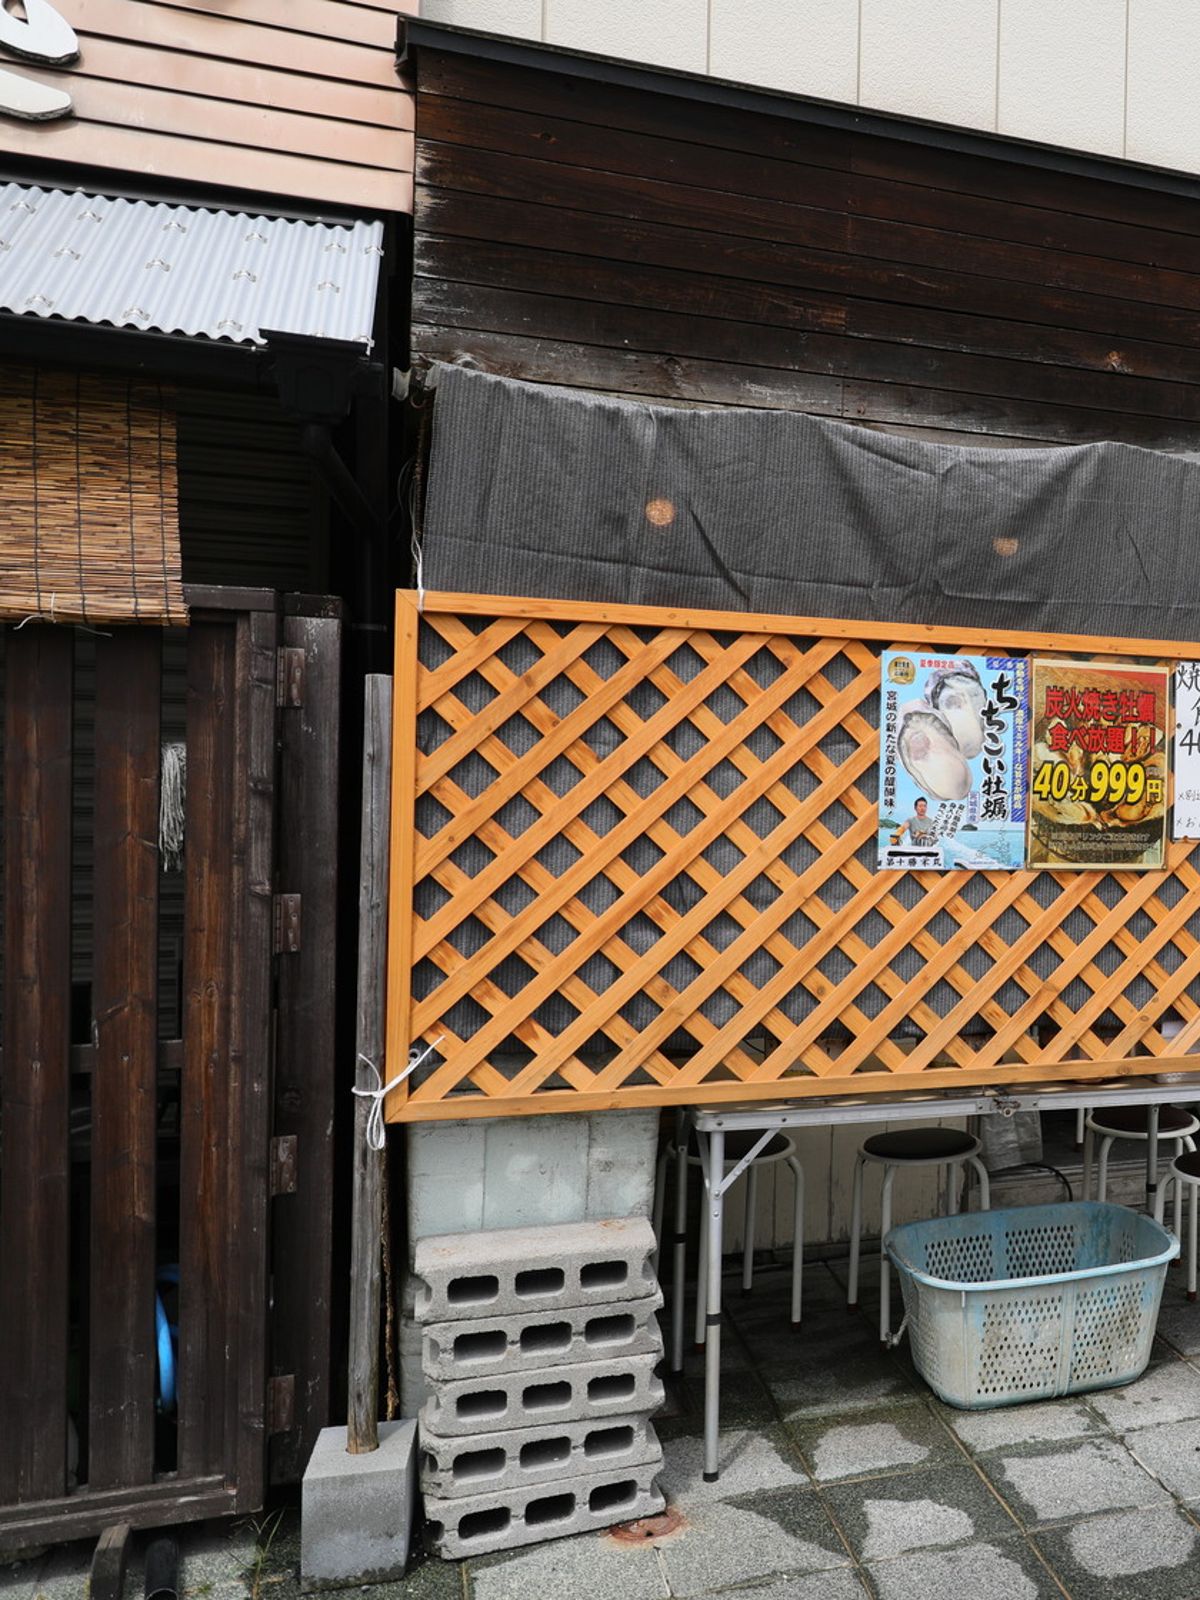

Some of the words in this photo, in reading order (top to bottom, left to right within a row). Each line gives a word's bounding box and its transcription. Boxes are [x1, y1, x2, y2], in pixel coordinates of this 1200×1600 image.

[1045, 686, 1156, 723] 炭火焼き牡蠣
